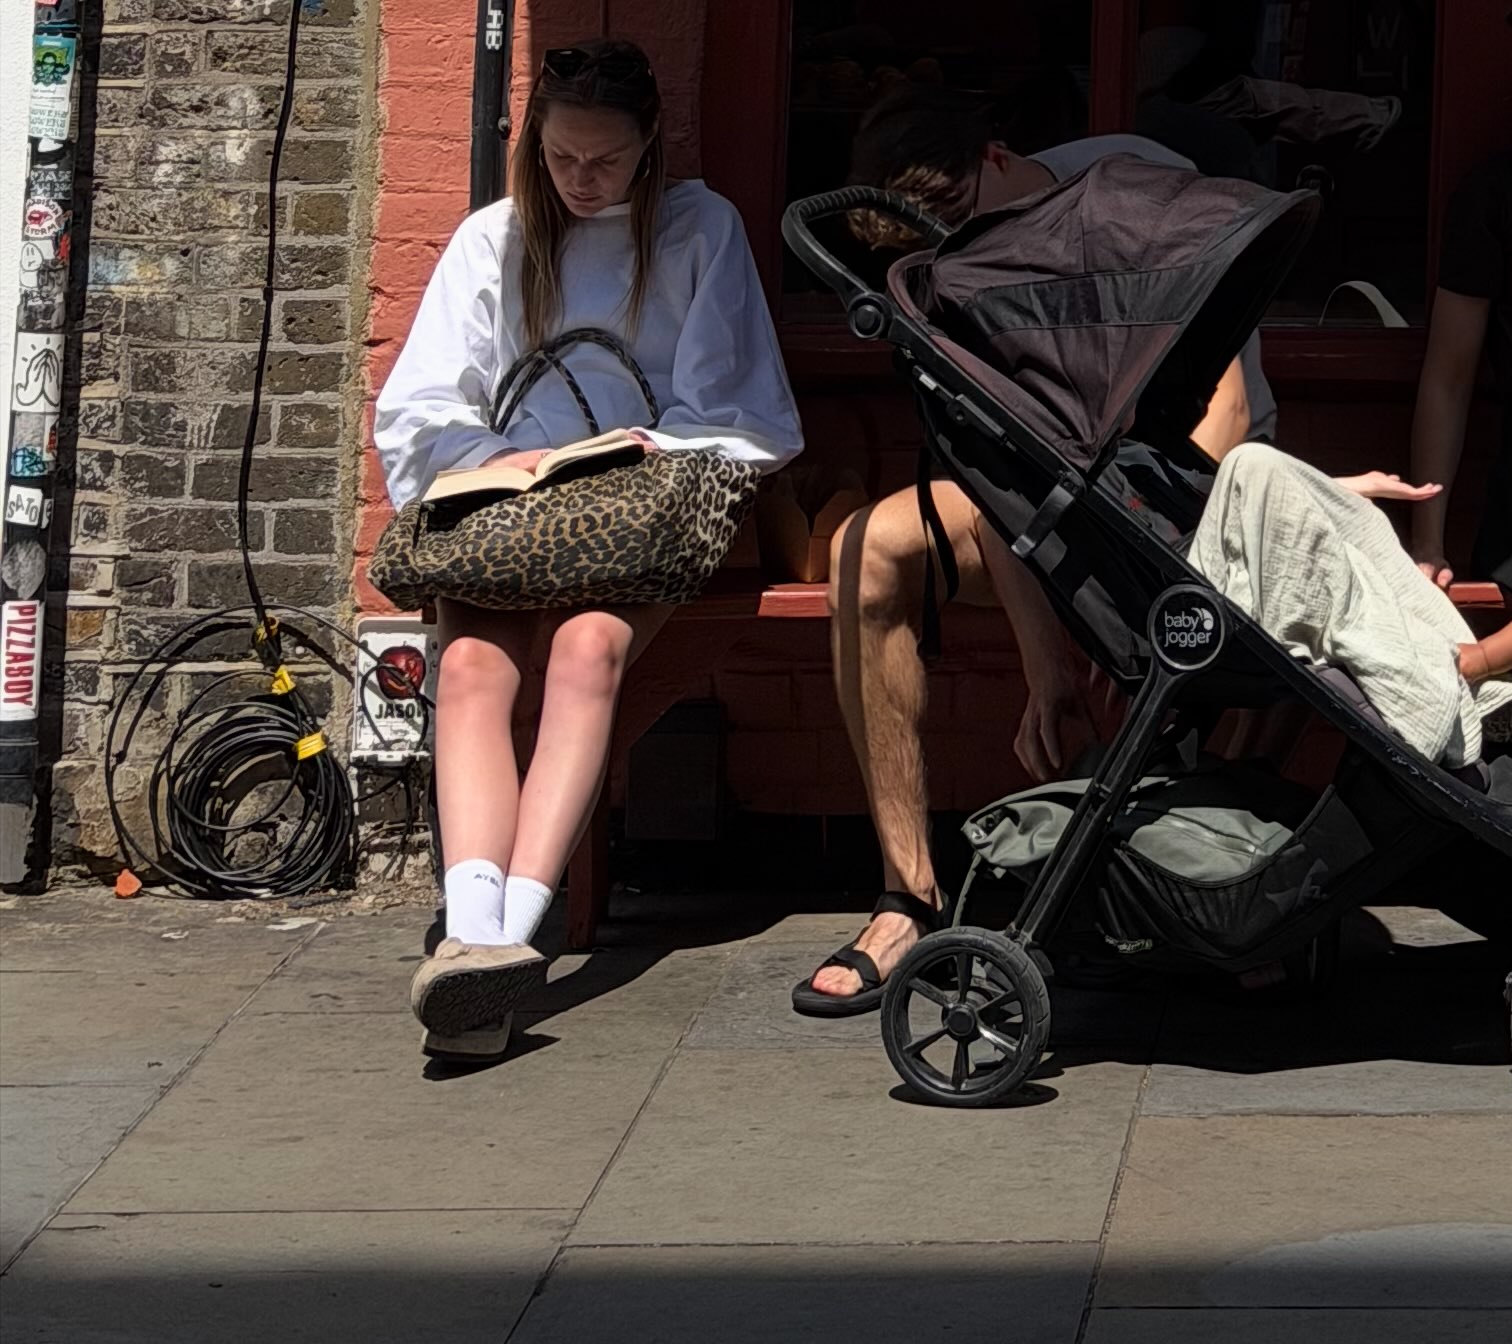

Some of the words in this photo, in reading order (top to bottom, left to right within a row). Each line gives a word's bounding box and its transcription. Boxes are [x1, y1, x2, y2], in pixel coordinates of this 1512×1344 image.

[1164, 610, 1200, 630] baby
[1164, 629, 1212, 648] jogger
[3, 604, 38, 707] PIZZABOY
